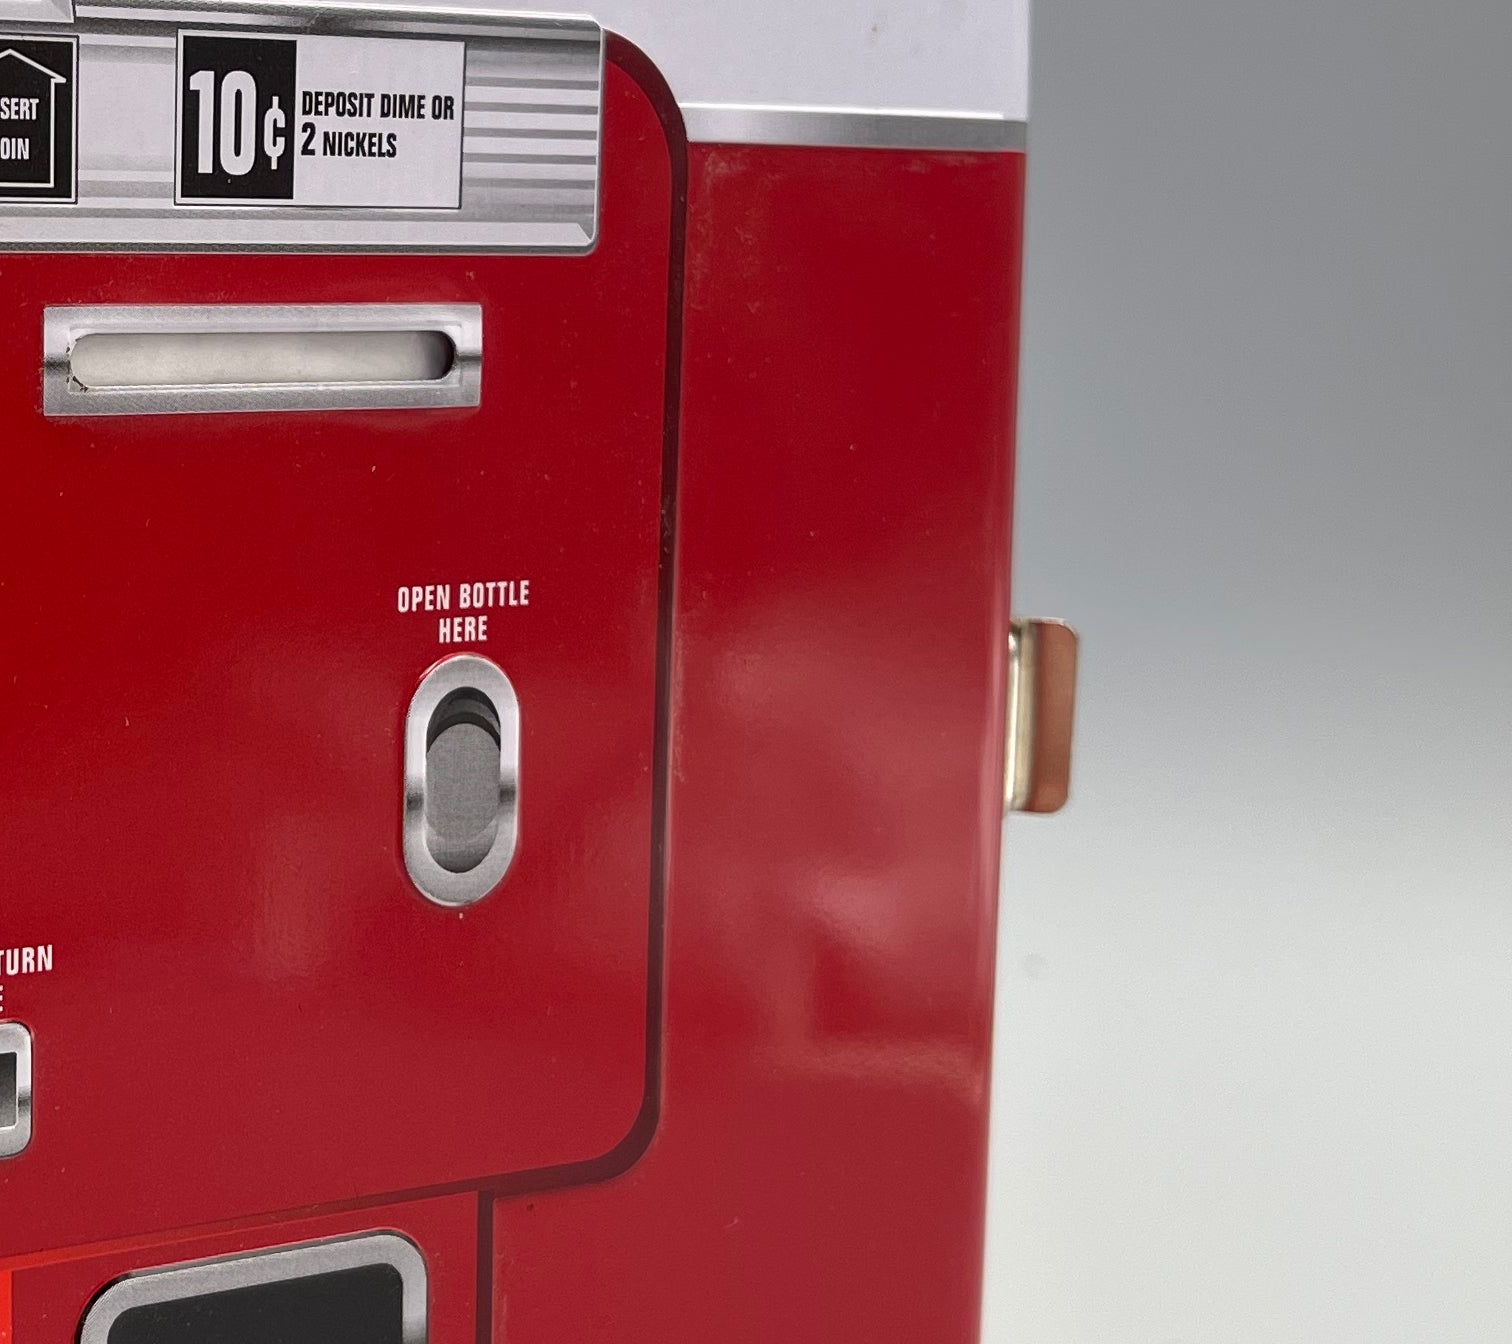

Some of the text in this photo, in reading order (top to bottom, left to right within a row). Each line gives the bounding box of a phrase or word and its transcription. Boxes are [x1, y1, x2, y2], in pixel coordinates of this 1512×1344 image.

[301, 90, 455, 121] DEPOSIT DIME OR
[189, 70, 286, 176] 10¢
[300, 121, 398, 158] 2 NICKELS
[397, 579, 530, 613] OPEN BOTTLE
[438, 615, 488, 644] HERE
